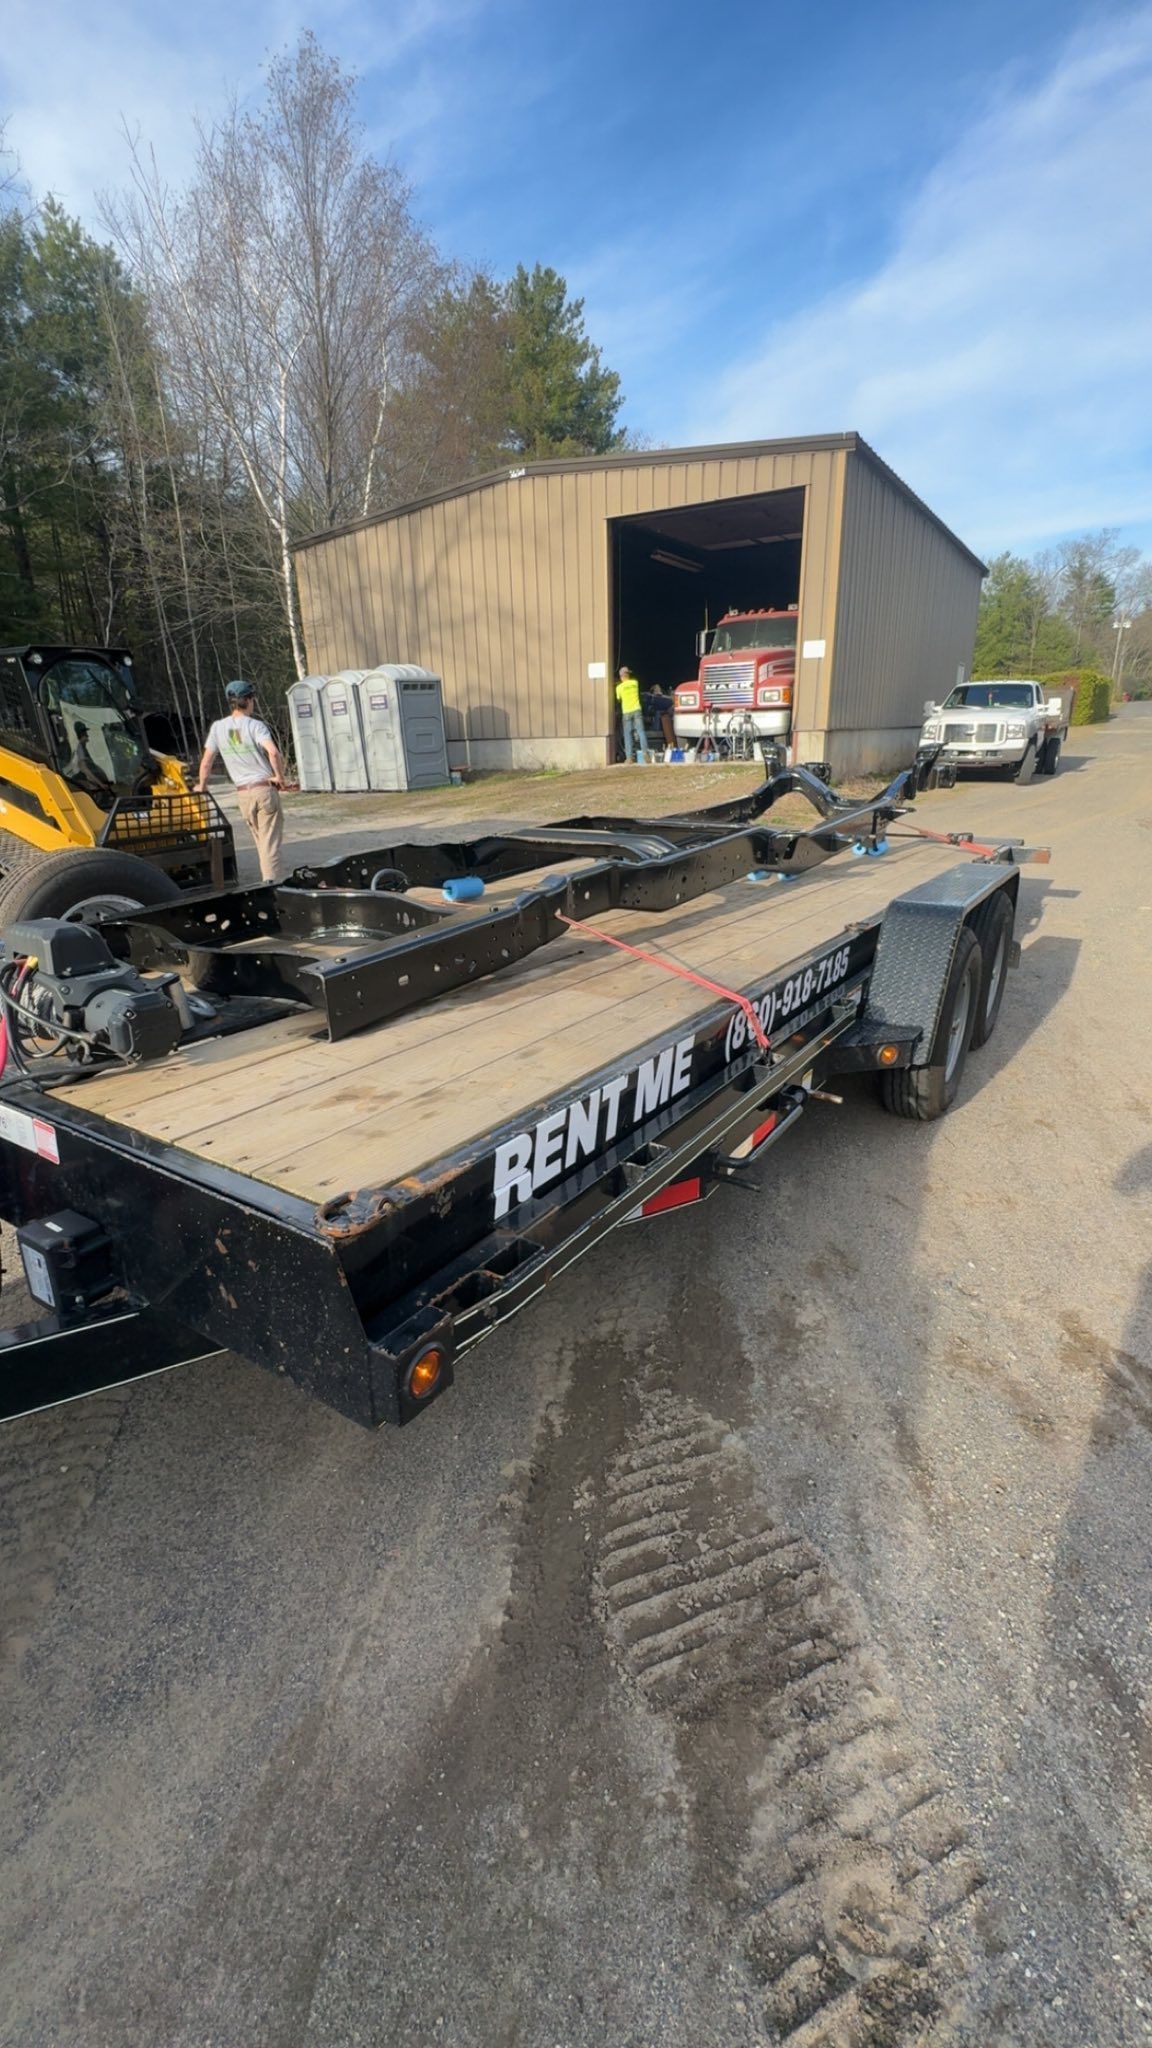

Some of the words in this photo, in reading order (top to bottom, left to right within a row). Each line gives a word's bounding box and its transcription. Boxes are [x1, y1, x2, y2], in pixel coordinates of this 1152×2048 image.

[705, 681, 753, 690] MACK
[494, 1075, 628, 1220] RENT
[634, 1034, 695, 1123] ME
